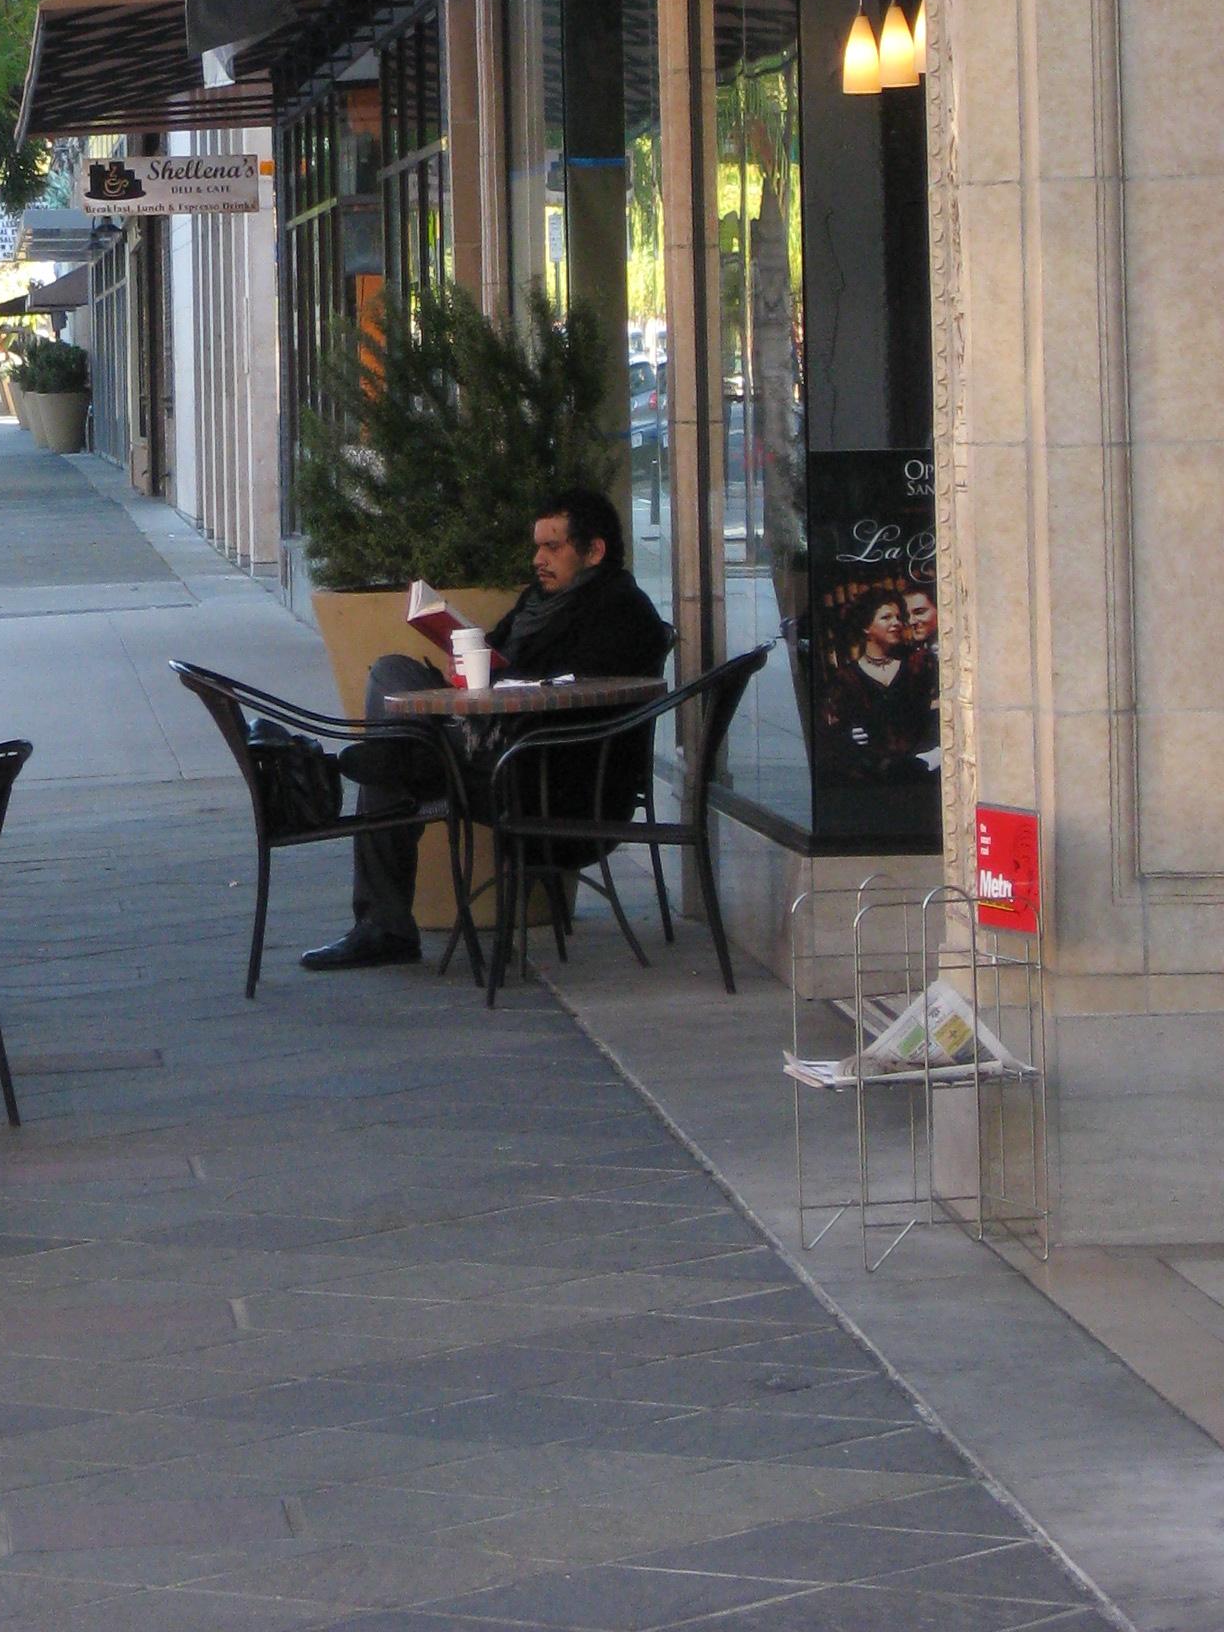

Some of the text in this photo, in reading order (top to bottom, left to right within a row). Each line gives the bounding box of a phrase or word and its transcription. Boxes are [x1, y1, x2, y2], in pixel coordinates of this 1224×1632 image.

[147, 158, 255, 181] Shellena's
[171, 186, 192, 194] DELI
[137, 202, 165, 212] Lunch
[178, 203, 220, 213] Espresso
[836, 519, 903, 563] La
